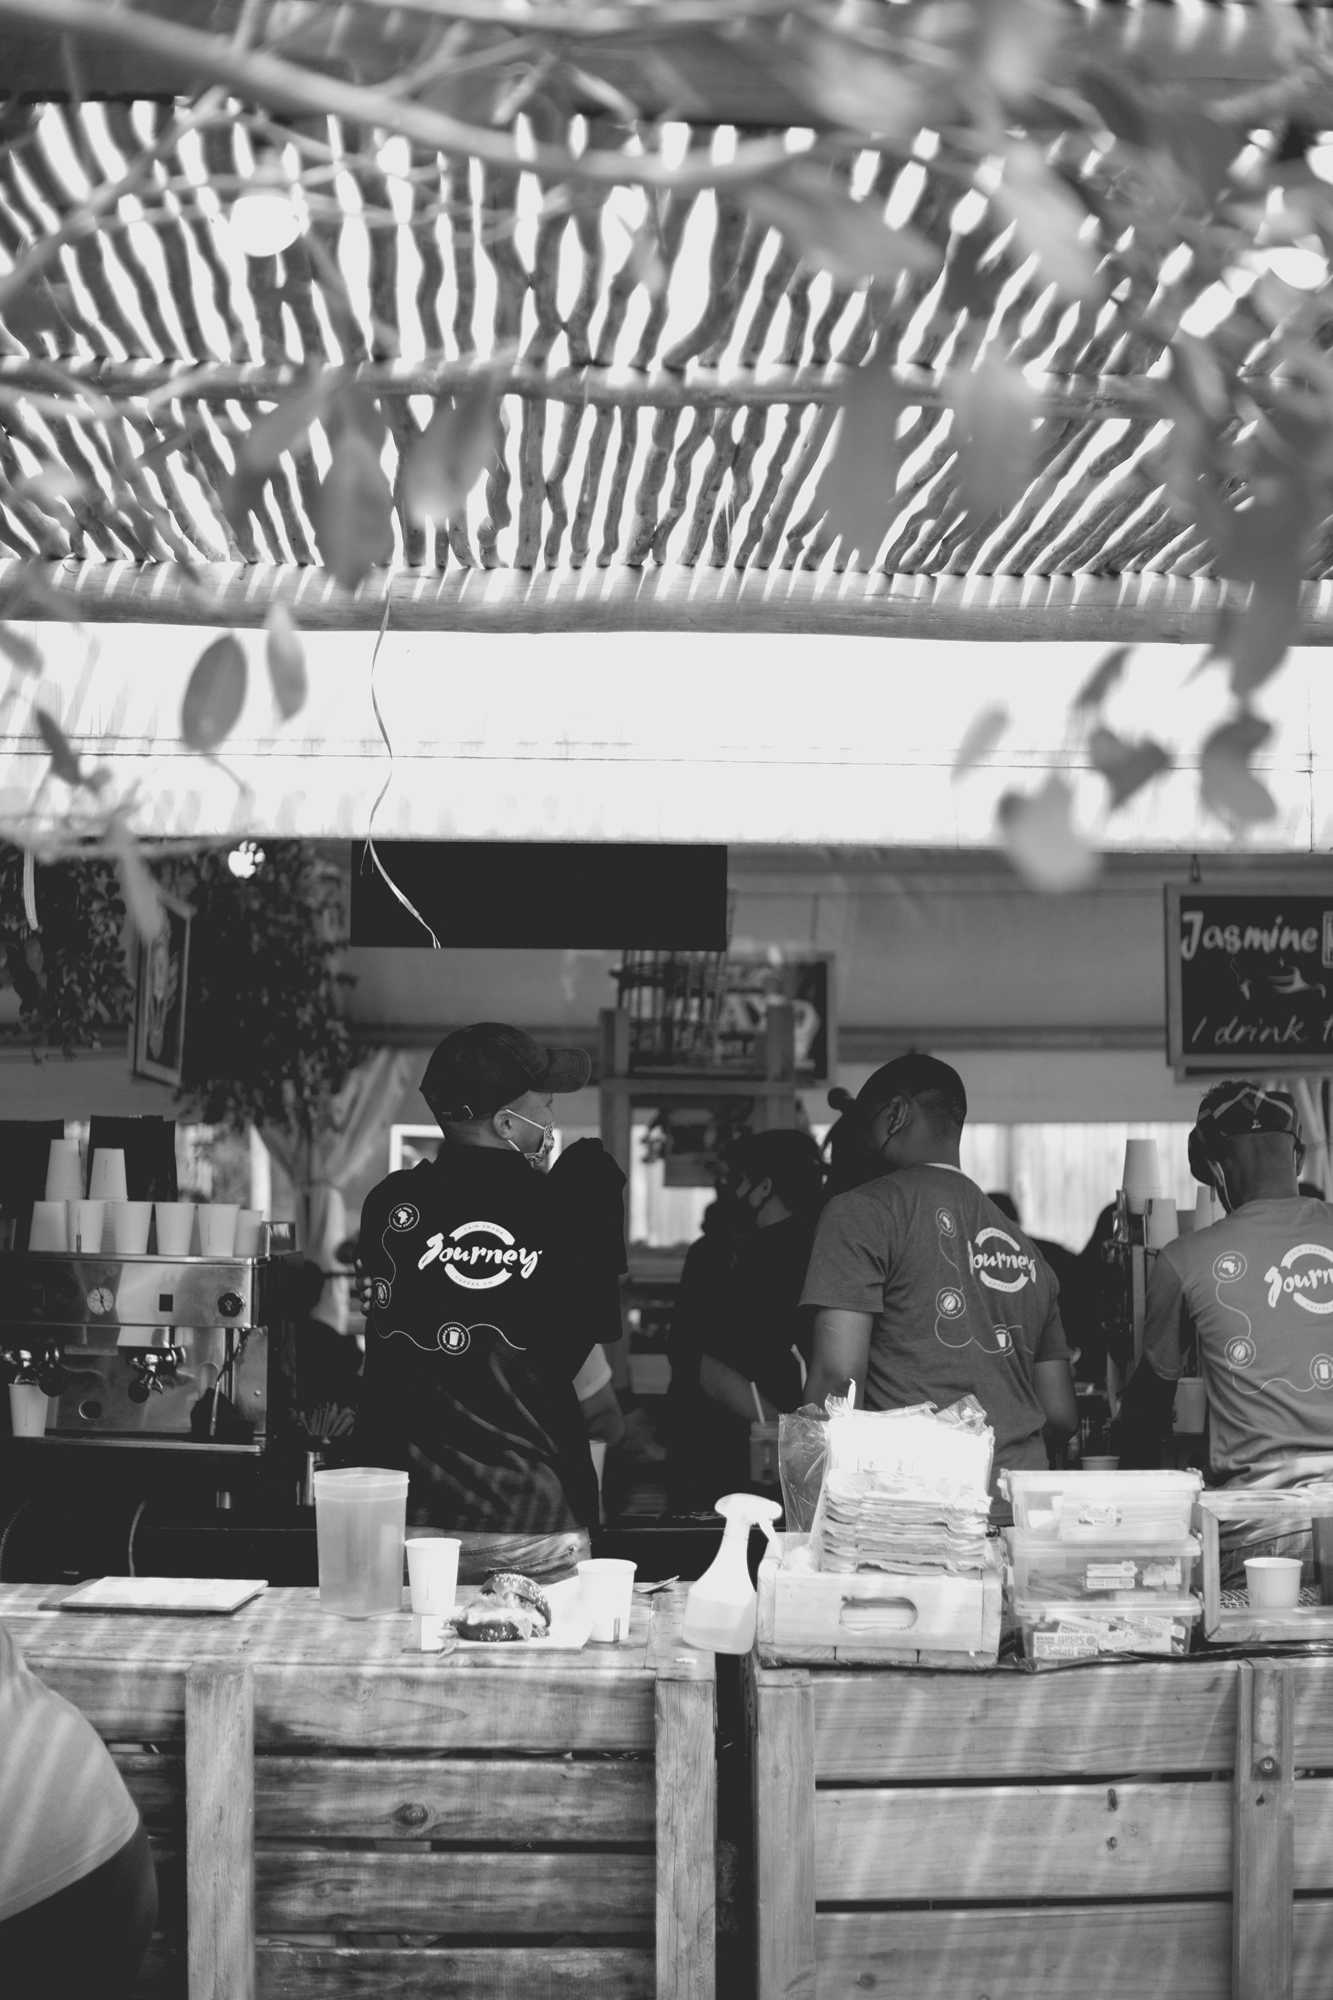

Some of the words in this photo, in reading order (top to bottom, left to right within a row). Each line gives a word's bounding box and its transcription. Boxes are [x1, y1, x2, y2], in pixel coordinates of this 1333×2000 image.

[1181, 911, 1319, 961] Jasmine
[1214, 1014, 1310, 1045] drink
[482, 1224, 504, 1235] TRADE
[418, 1232, 542, 1279] Journey
[455, 1275, 480, 1286] COFFEE
[1058, 1635, 1085, 1646] Selati
[1047, 1646, 1075, 1656] Selati
